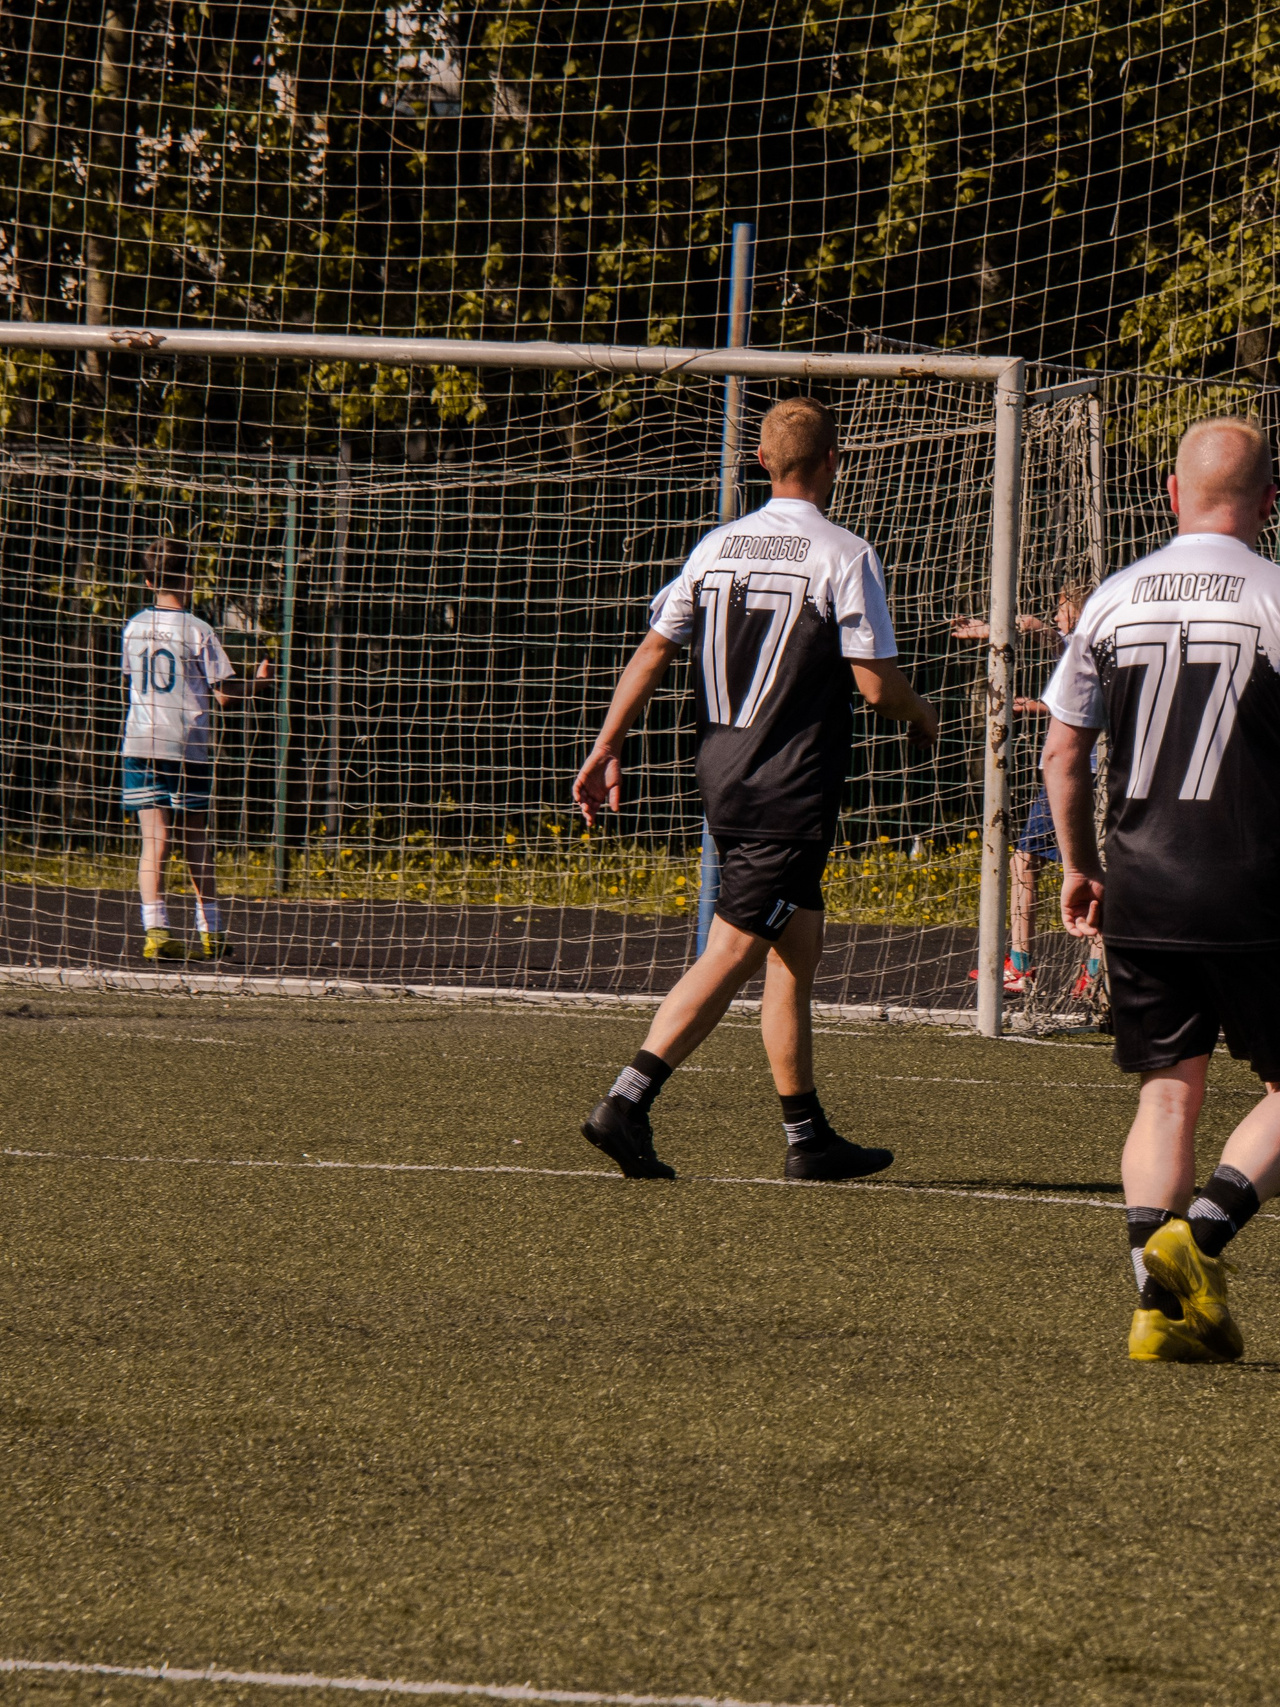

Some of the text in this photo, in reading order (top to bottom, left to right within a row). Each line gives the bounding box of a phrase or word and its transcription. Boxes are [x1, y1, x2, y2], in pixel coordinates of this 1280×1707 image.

[1131, 573, 1246, 604] ГИМОРИН
[138, 648, 176, 695] 10
[700, 570, 810, 729] 17
[1114, 620, 1261, 801] 77
[765, 899, 799, 930] 17
